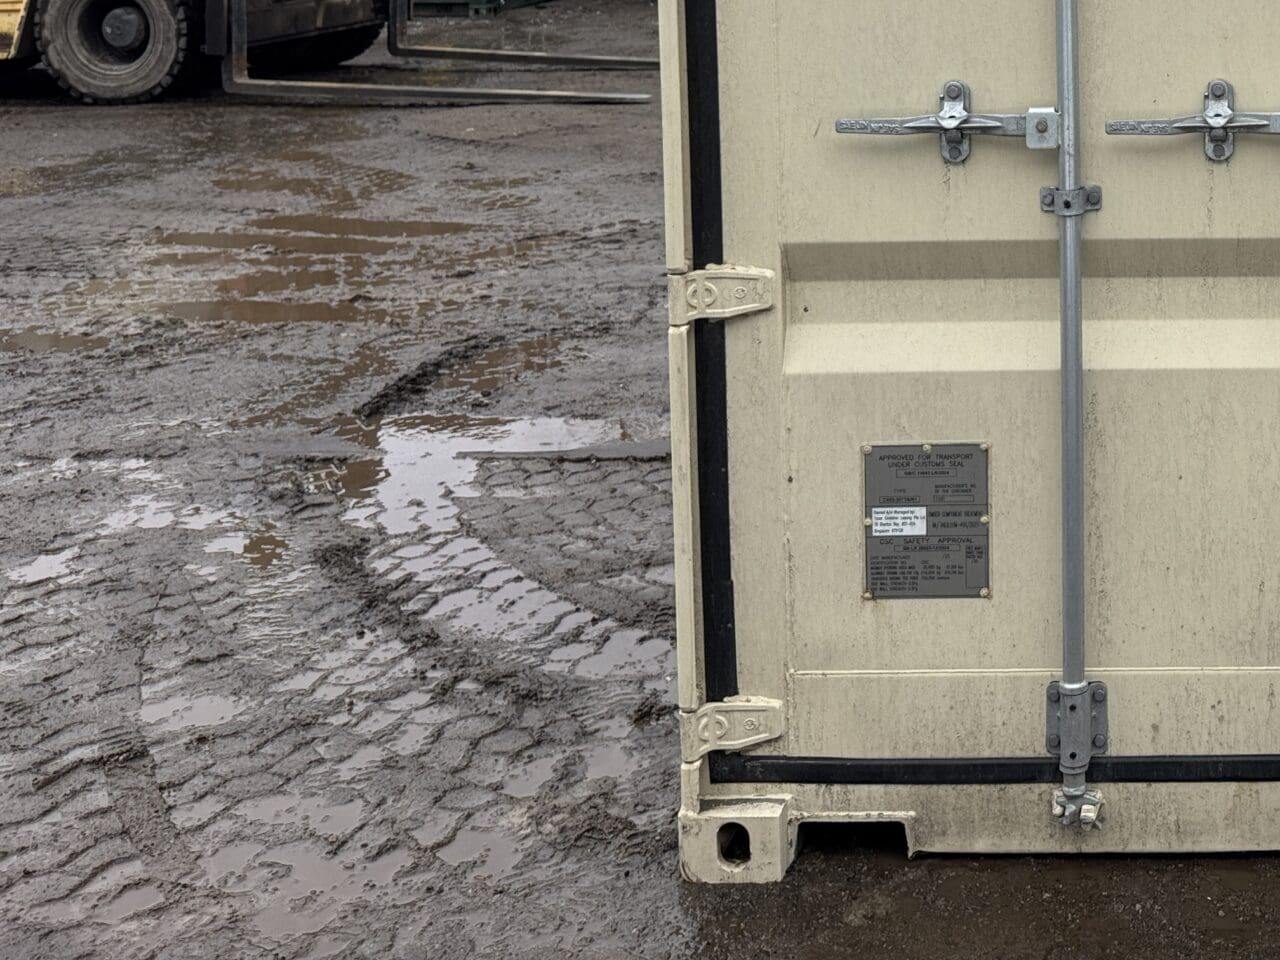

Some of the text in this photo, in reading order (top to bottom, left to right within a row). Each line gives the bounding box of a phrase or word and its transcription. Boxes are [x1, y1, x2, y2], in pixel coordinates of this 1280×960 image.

[918, 453, 933, 461] FOR
[935, 453, 974, 461] TRANSPORT
[887, 461, 911, 469] UNDER
[948, 460, 965, 468] SEAL
[903, 537, 930, 545] SAFETY
